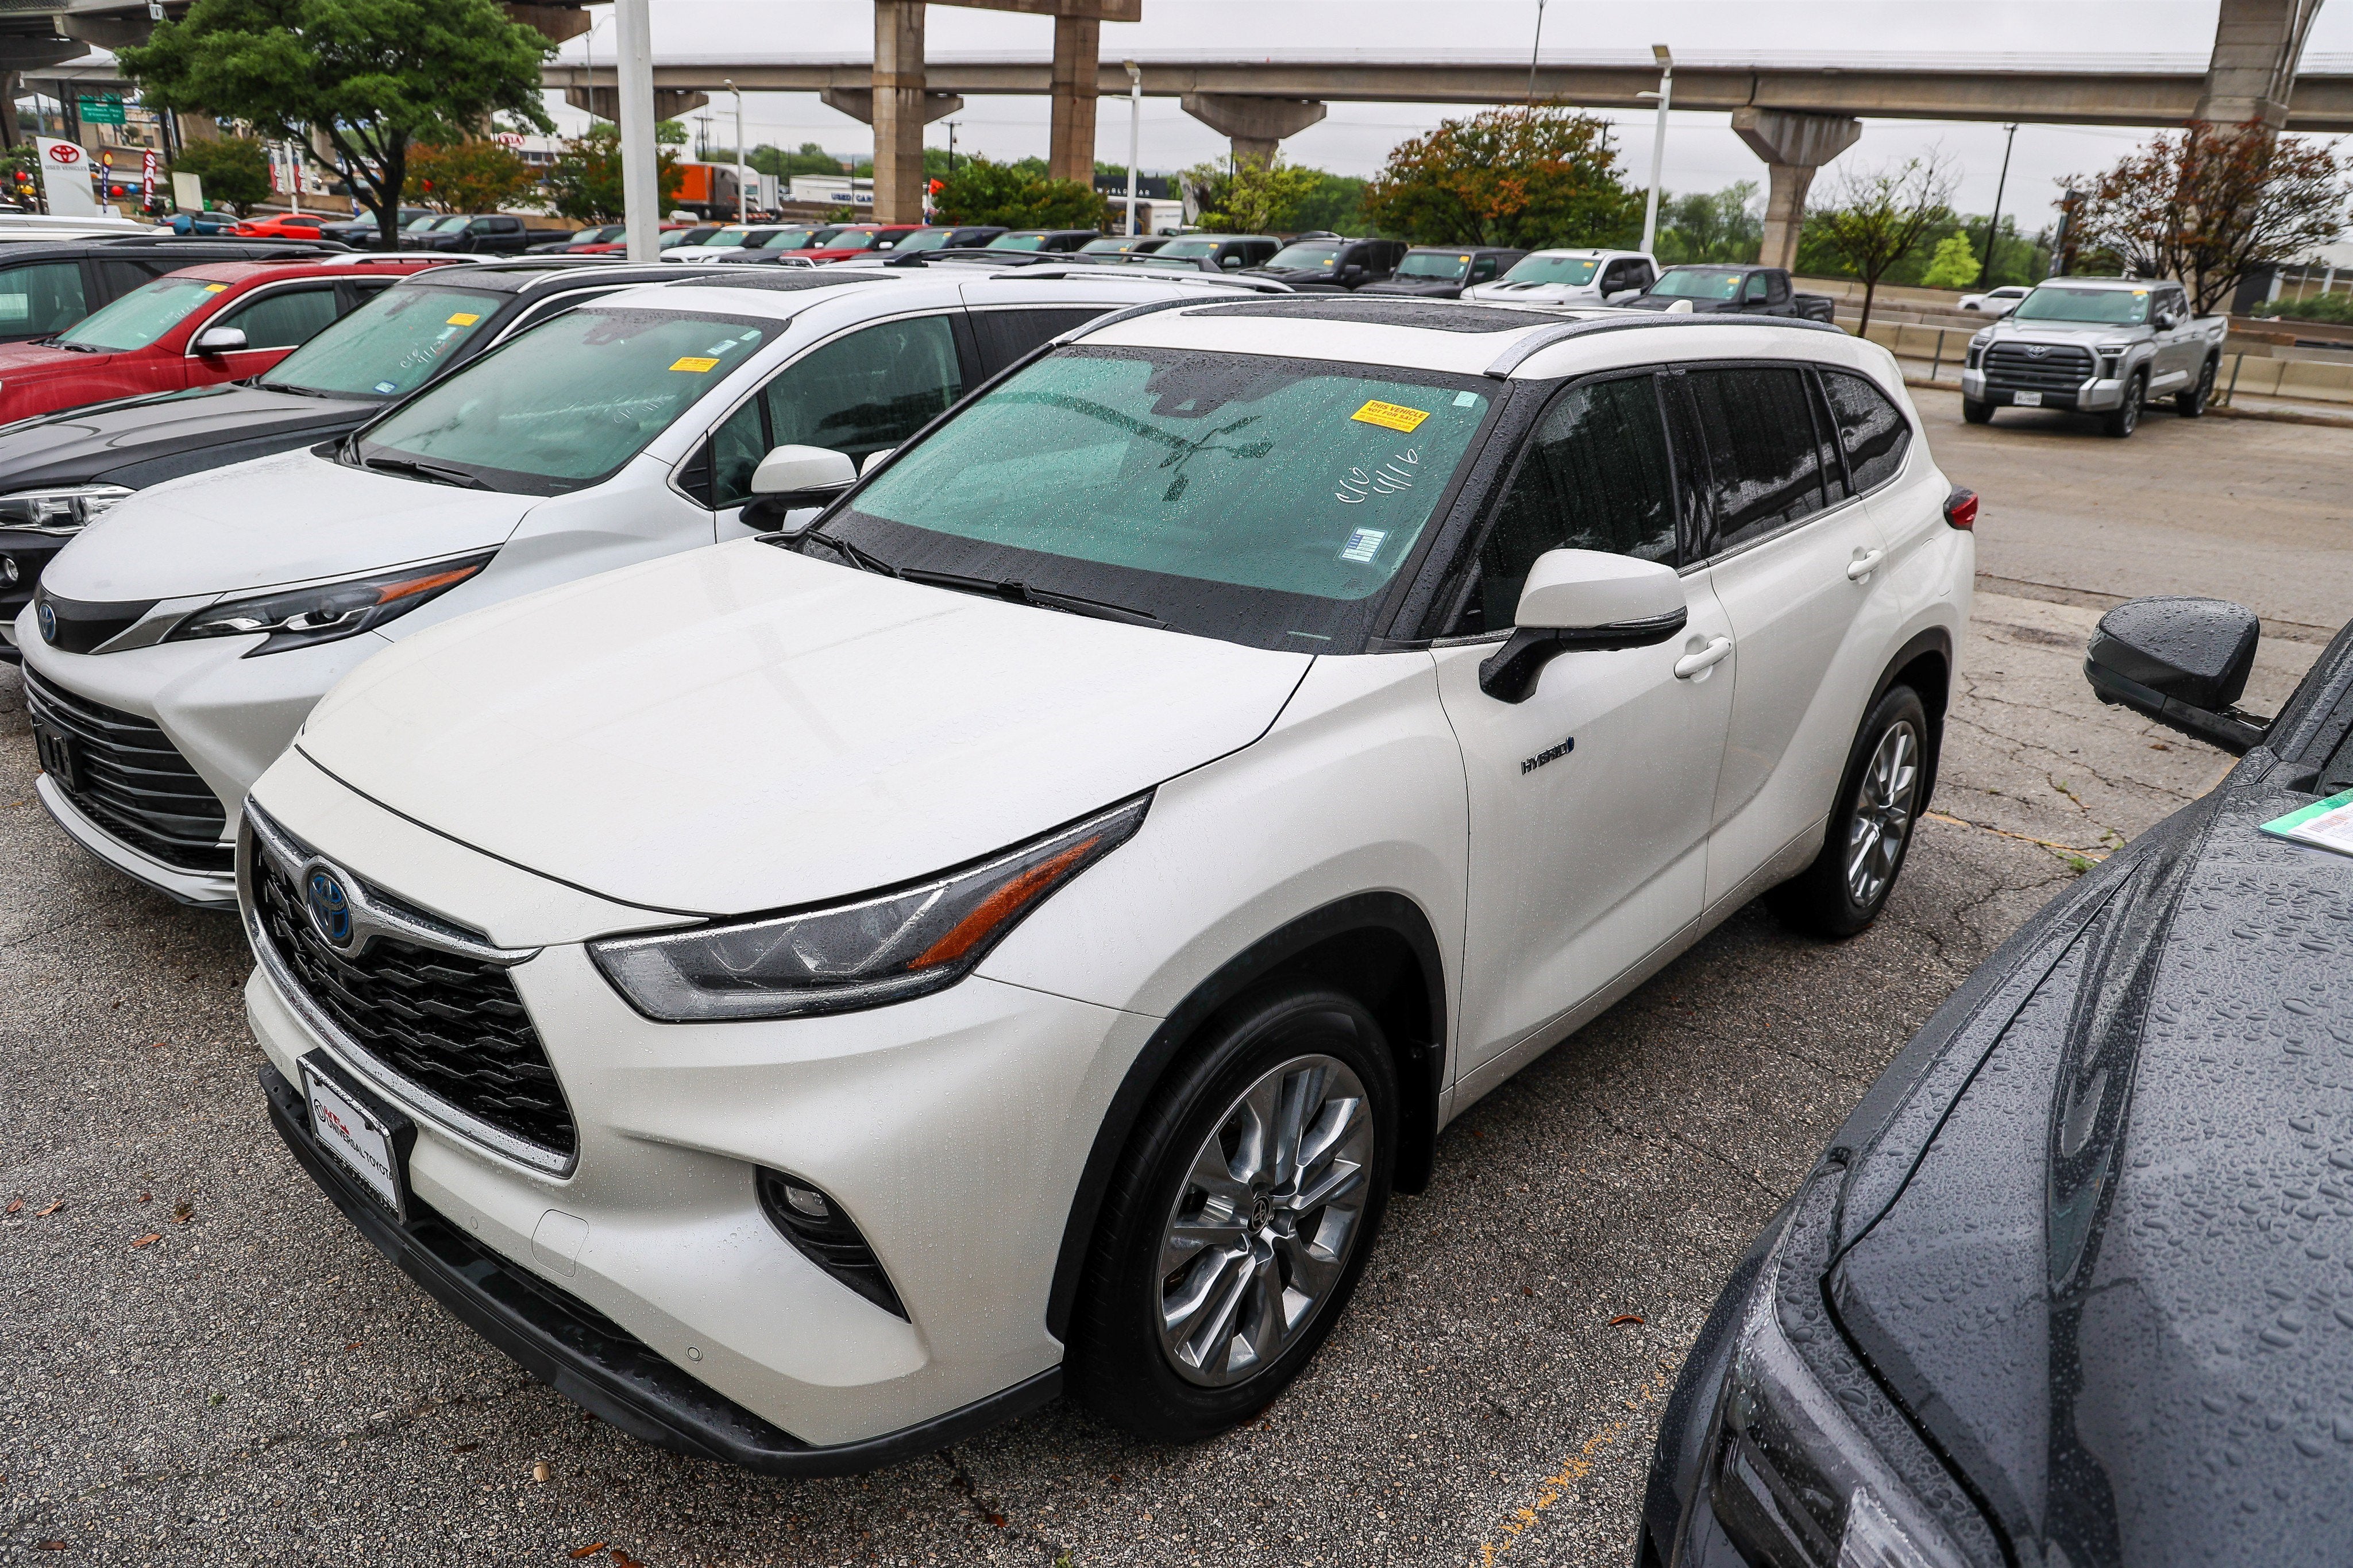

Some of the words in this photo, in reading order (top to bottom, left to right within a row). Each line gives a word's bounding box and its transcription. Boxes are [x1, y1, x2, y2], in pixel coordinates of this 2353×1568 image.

[145, 153, 155, 206] SALE
[831, 192, 851, 200] USED
[1390, 406, 1426, 418] VEHICLE
[1399, 414, 1418, 422] SALE
[1521, 741, 1567, 775] HYBRID
[326, 1117, 365, 1159] UNIVERSAL
